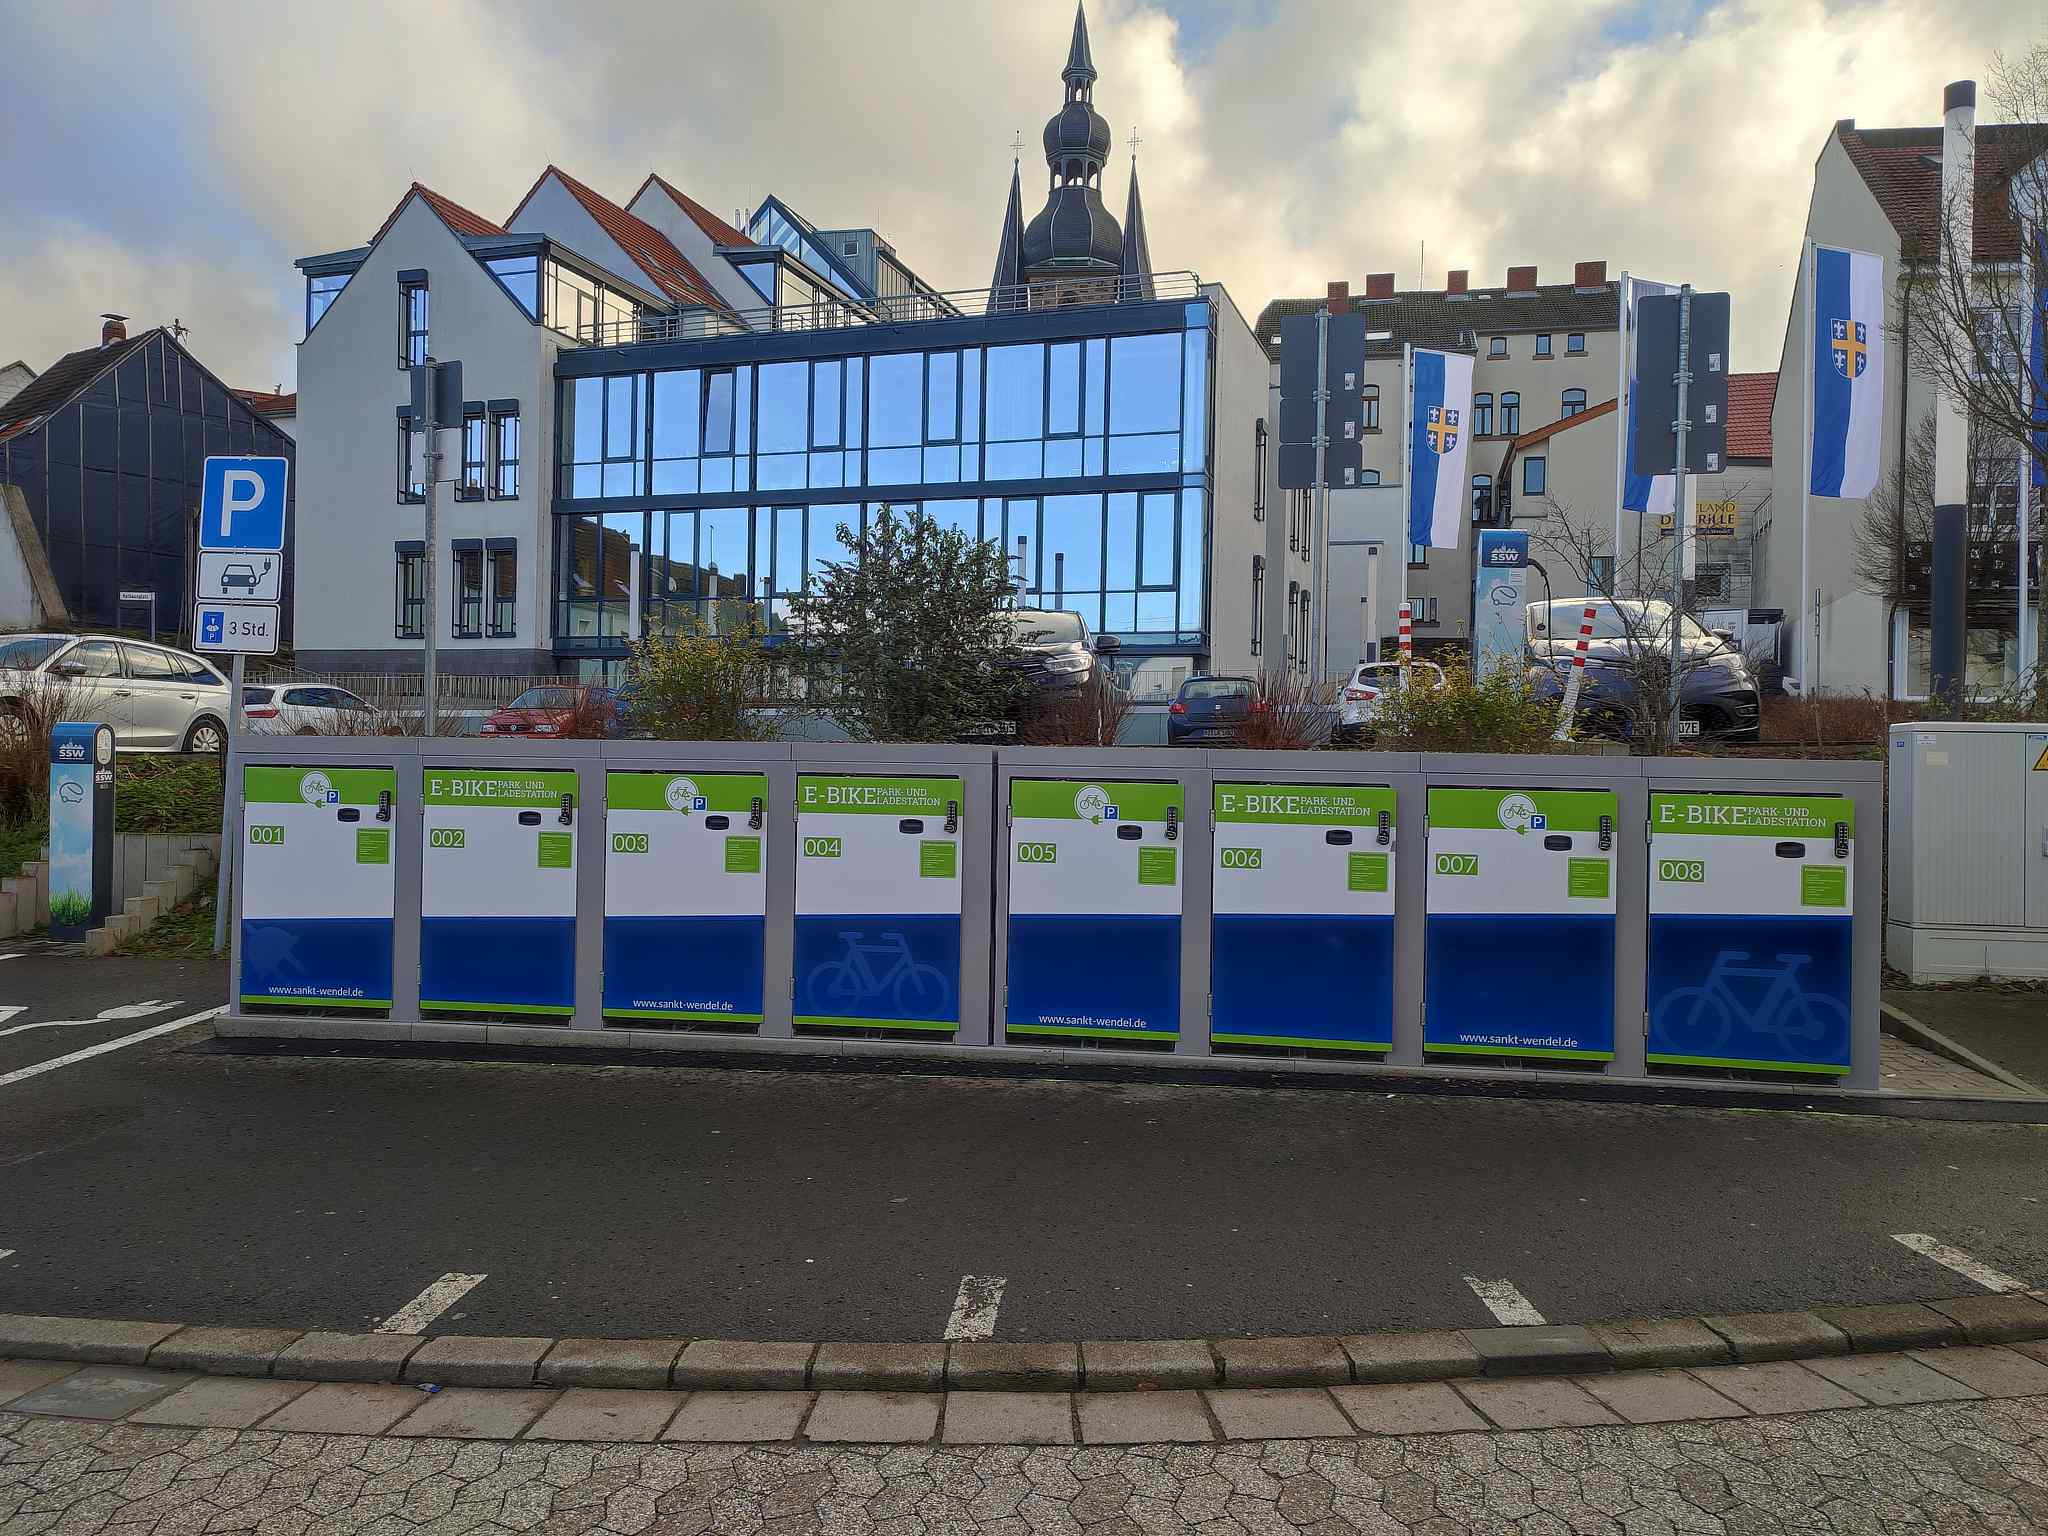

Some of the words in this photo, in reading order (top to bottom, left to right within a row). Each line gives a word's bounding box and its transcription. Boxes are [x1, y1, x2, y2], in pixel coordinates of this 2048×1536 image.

[220, 470, 265, 536] P
[1491, 553, 1519, 561] SSW
[229, 622, 237, 634] 3
[241, 623, 269, 637] Std.
[59, 749, 85, 757] SSW
[430, 779, 498, 797] E-BIKE
[526, 781, 545, 789] UND
[498, 789, 557, 799] LADESTATION
[804, 786, 876, 804] E-BIKE
[907, 788, 927, 797] UND
[876, 796, 941, 806] LADESTATION
[1221, 794, 1300, 814] E-BIKE
[1333, 797, 1356, 806] UND
[1300, 805, 1371, 816] LADESTATION
[1660, 804, 1747, 825] E-BIKE
[1784, 808, 1809, 817] UND
[1748, 817, 1826, 828] LADESTATION
[251, 827, 283, 843] 001
[431, 830, 464, 847] 002
[614, 835, 647, 852] 003
[805, 839, 840, 856] 004
[1019, 844, 1055, 861] 005
[1222, 849, 1261, 867] 006
[1437, 855, 1477, 873] 007
[1660, 862, 1703, 880] 008
[268, 986, 364, 997] www.sankt-wendel.de
[633, 1000, 733, 1011] www.sankt-wendel.de
[1039, 1016, 1147, 1029] www.sankt-wendel.de
[1460, 1033, 1578, 1048] www.sankt-wendel.de
